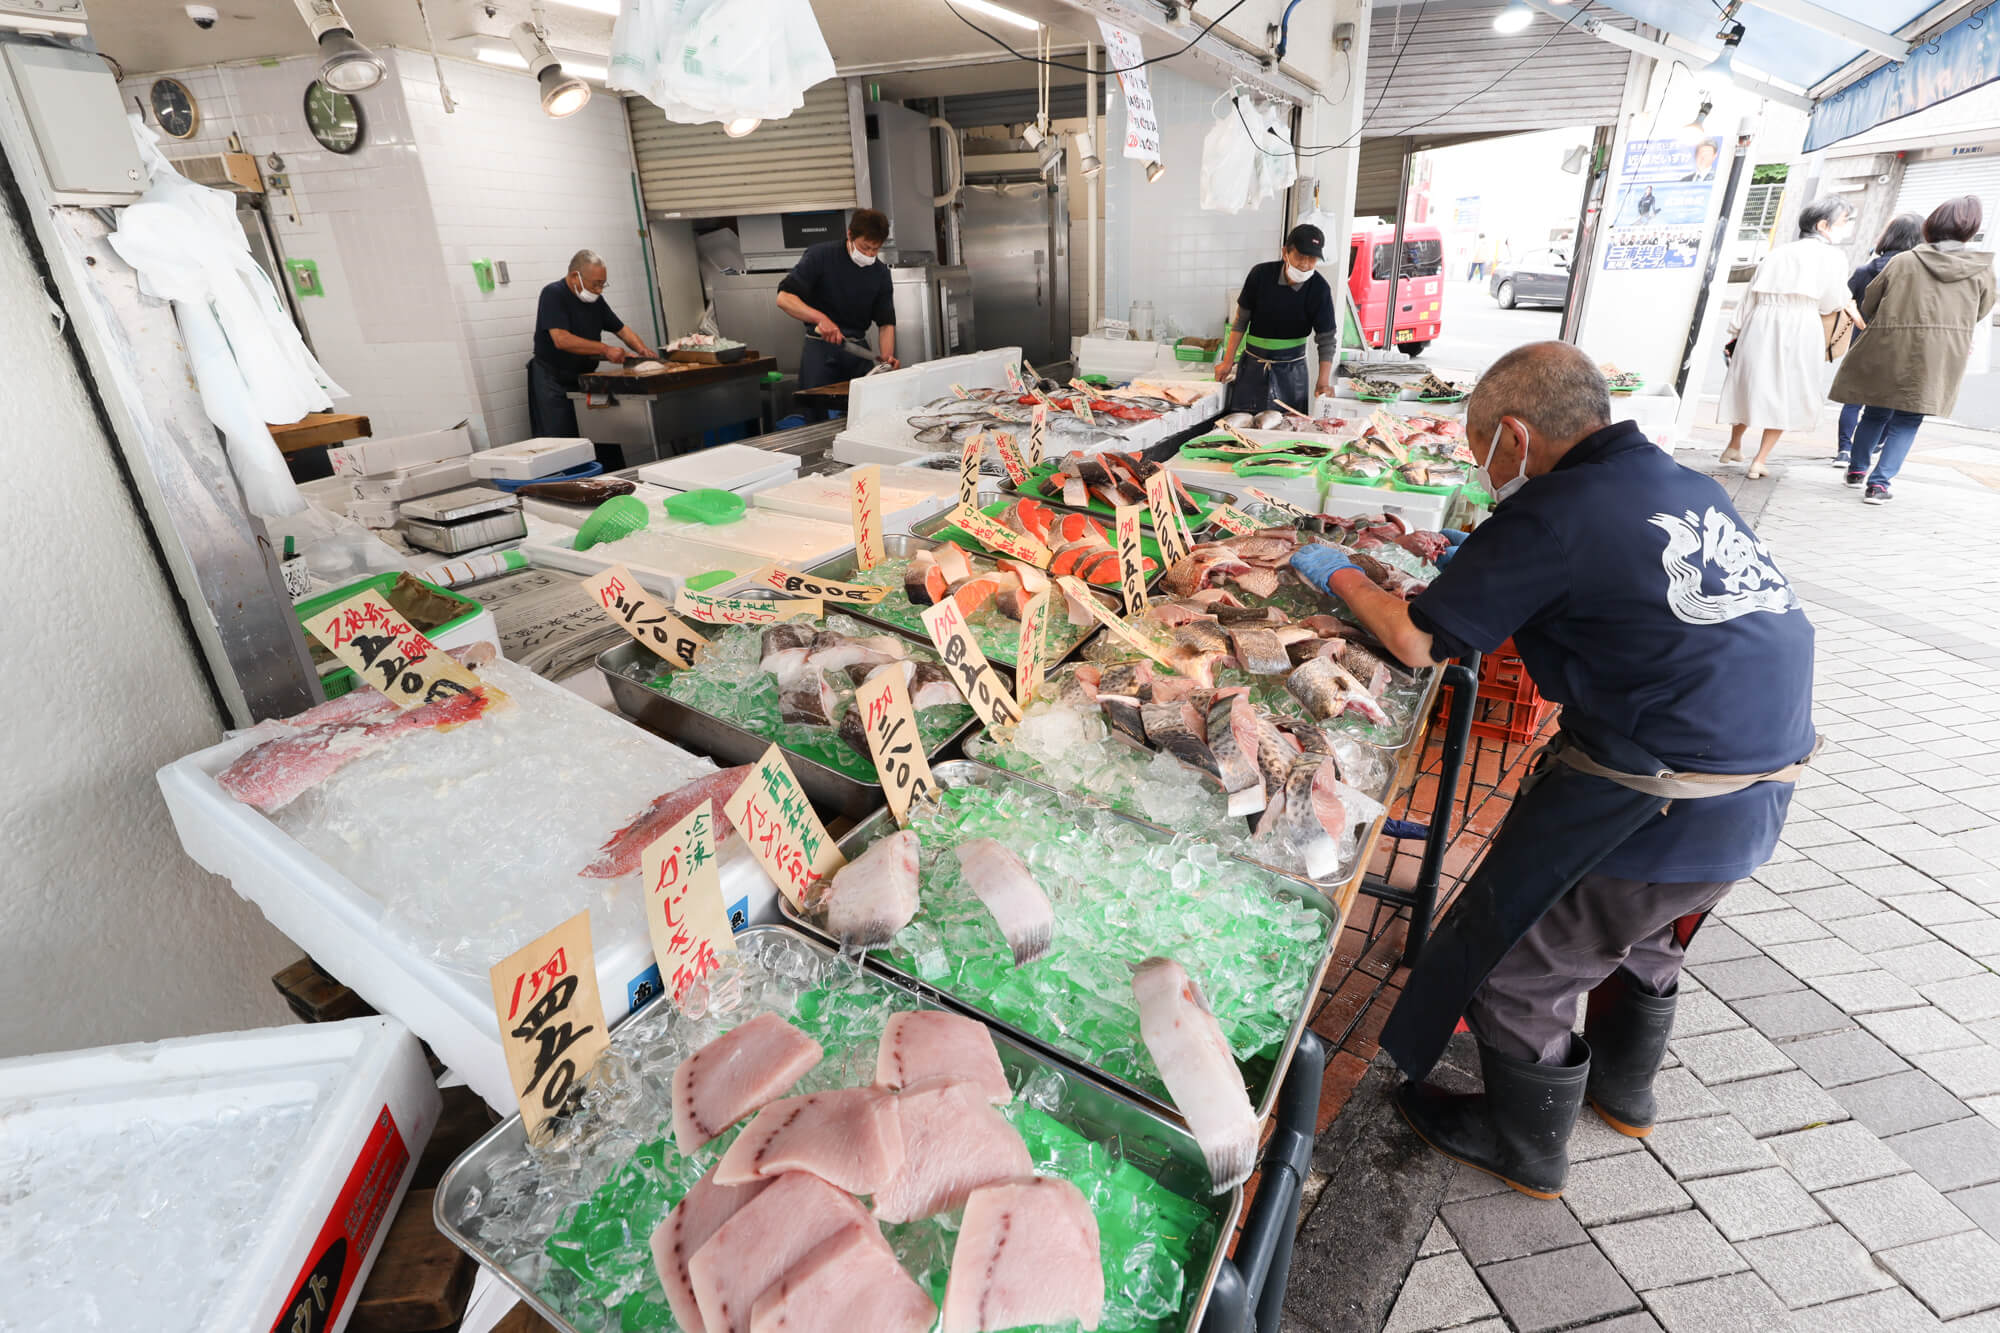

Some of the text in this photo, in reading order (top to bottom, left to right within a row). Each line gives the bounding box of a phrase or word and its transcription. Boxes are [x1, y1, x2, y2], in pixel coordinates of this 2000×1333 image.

[685, 814, 714, 877] 冷凍
[761, 762, 826, 866] 青森産
